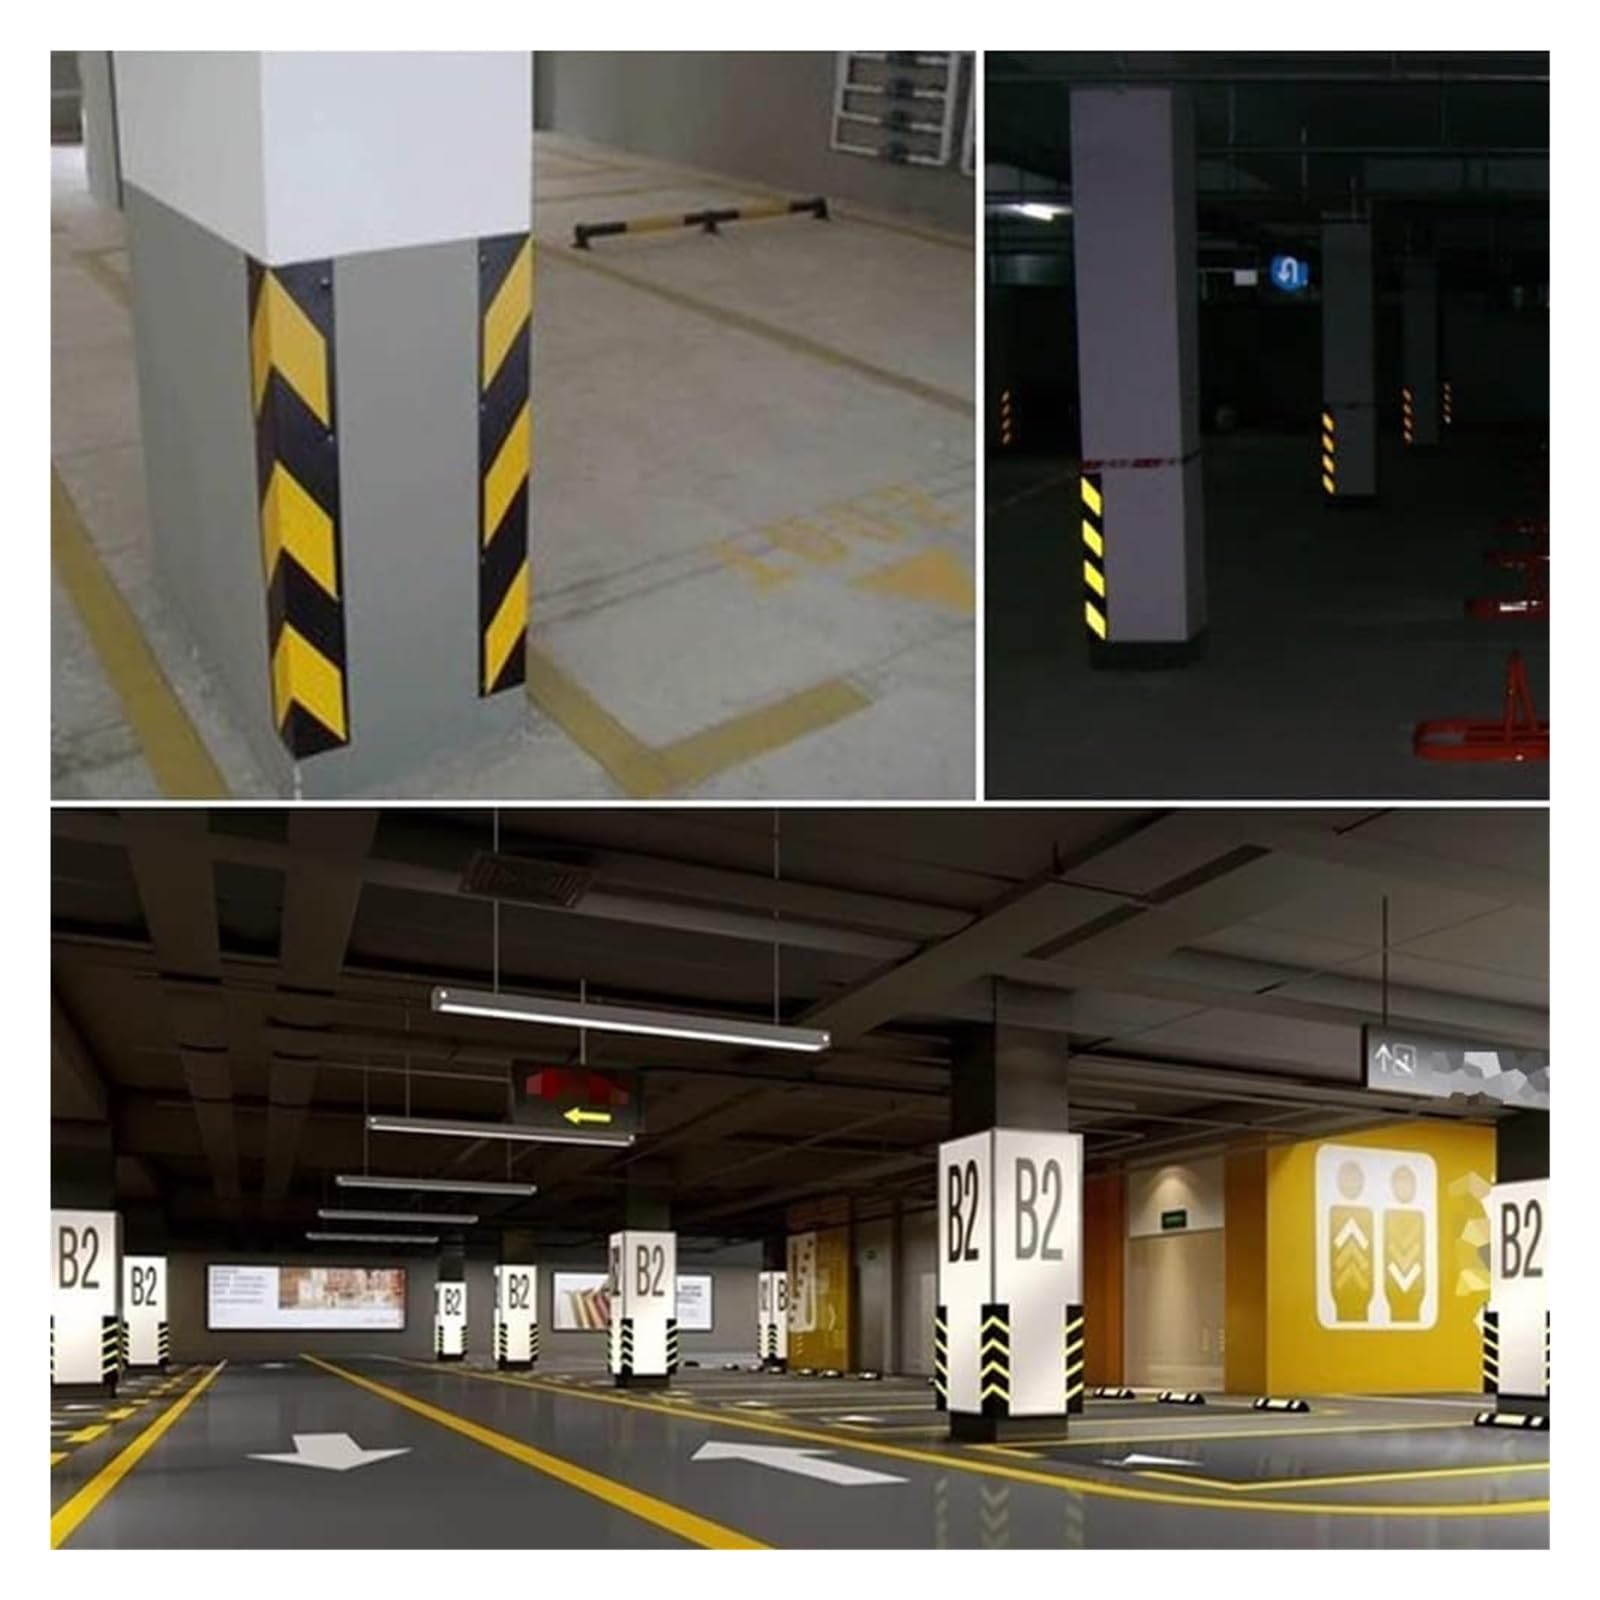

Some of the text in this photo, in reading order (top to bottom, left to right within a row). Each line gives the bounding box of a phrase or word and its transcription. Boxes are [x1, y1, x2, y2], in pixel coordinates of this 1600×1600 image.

[948, 1159, 979, 1263] B2
[1015, 1157, 1063, 1261] B2
[59, 1225, 100, 1289] B2
[1501, 1199, 1543, 1279] B2
[131, 1266, 157, 1307] B2
[509, 1273, 530, 1310] B2
[637, 1244, 665, 1297] B2
[777, 1279, 789, 1312] B
[445, 1287, 462, 1316] B2
